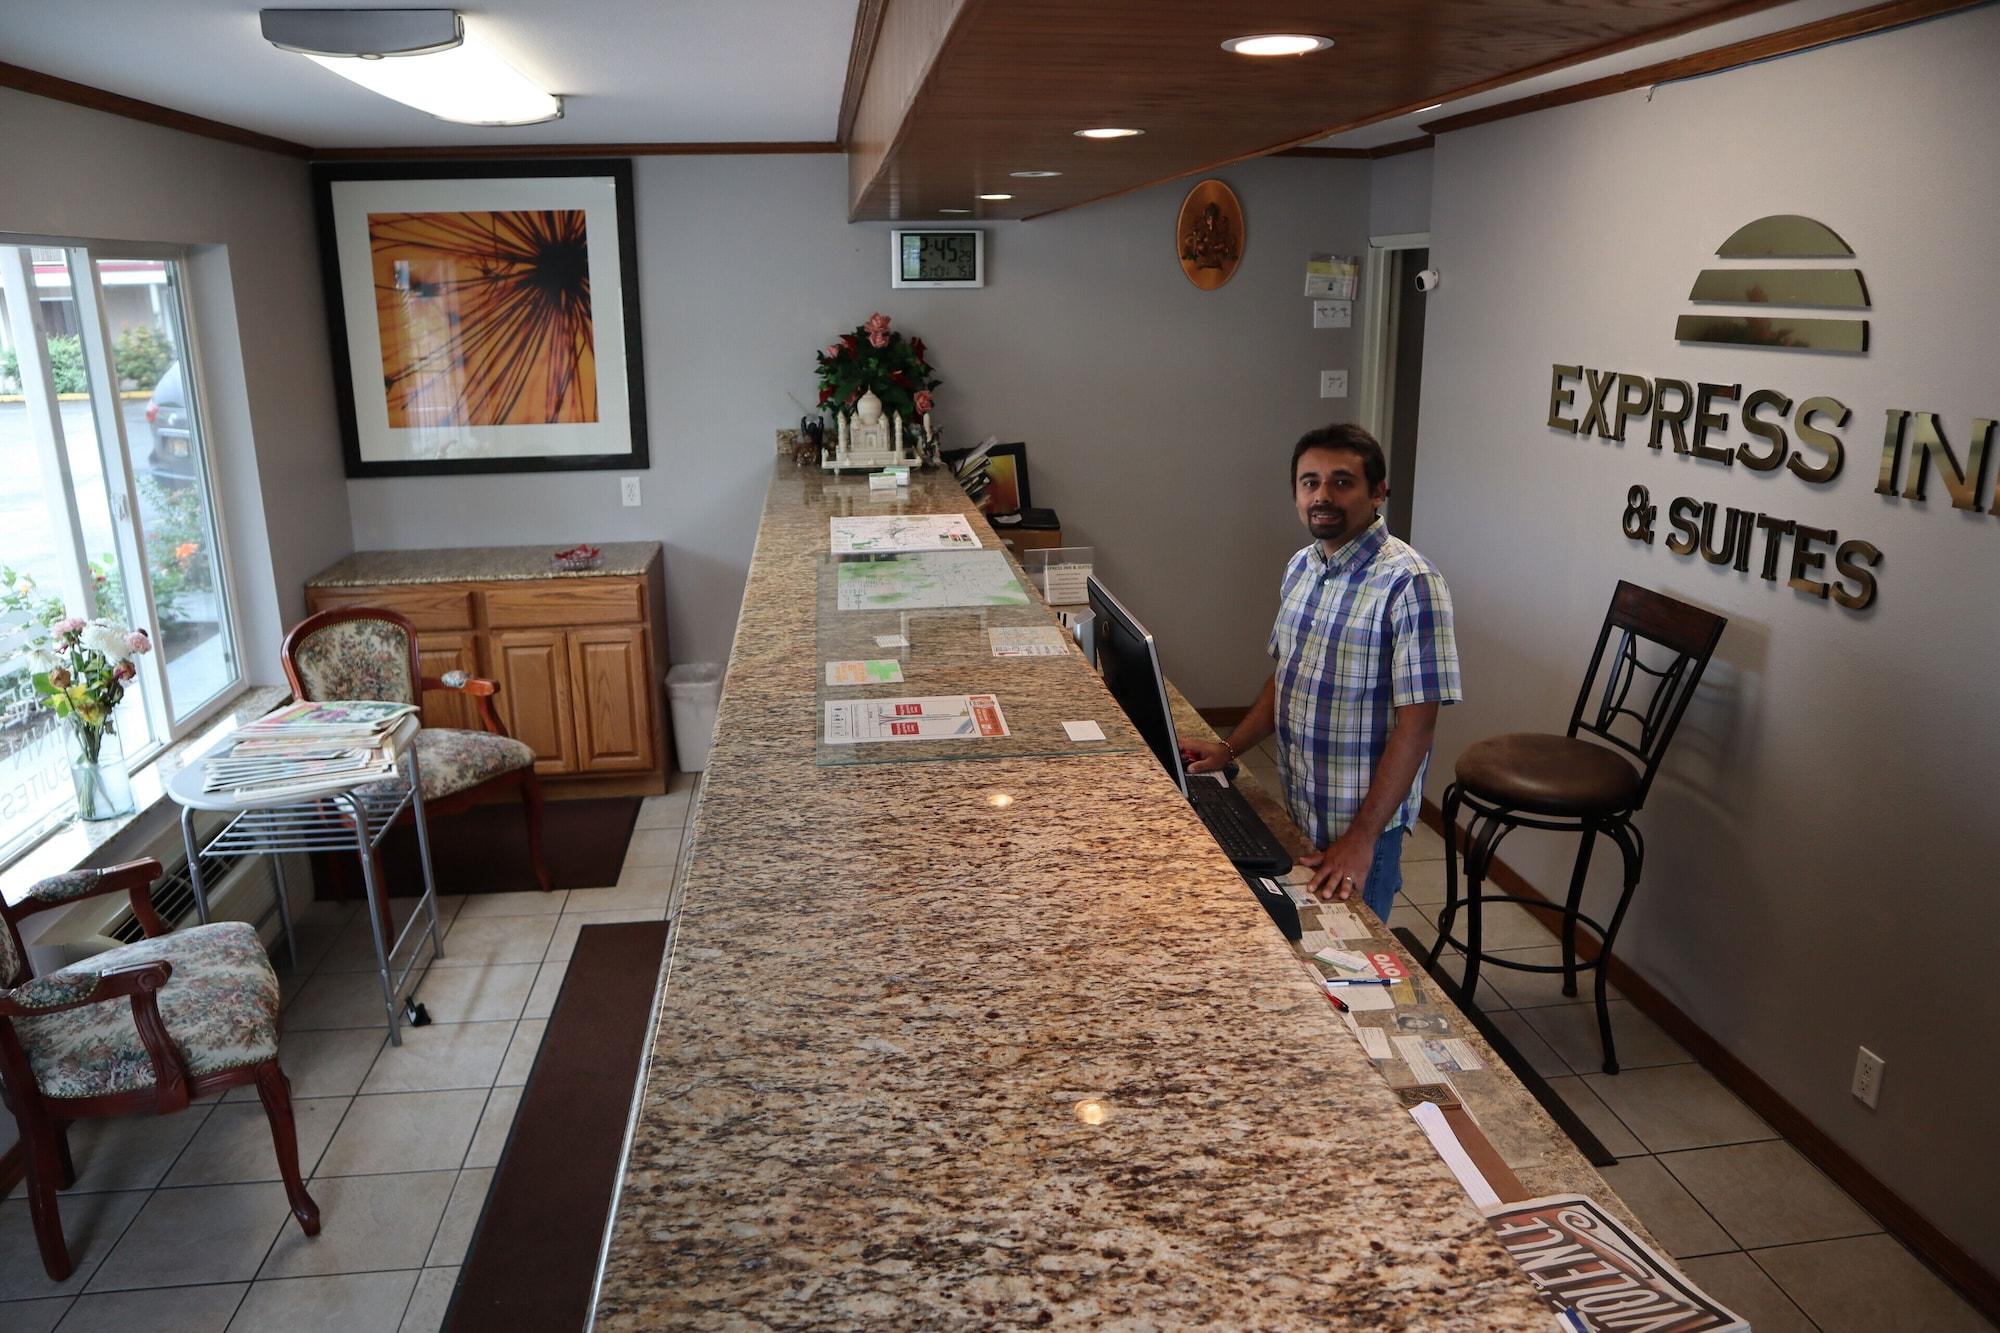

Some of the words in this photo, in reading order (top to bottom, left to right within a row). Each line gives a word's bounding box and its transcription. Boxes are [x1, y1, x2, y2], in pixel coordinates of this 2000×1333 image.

[1547, 364, 1852, 484] EXPRESS
[1875, 408, 2000, 517] IN
[1622, 484, 1657, 545] &
[1666, 496, 1884, 611] SUITES
[1373, 953, 1401, 977] OYO
